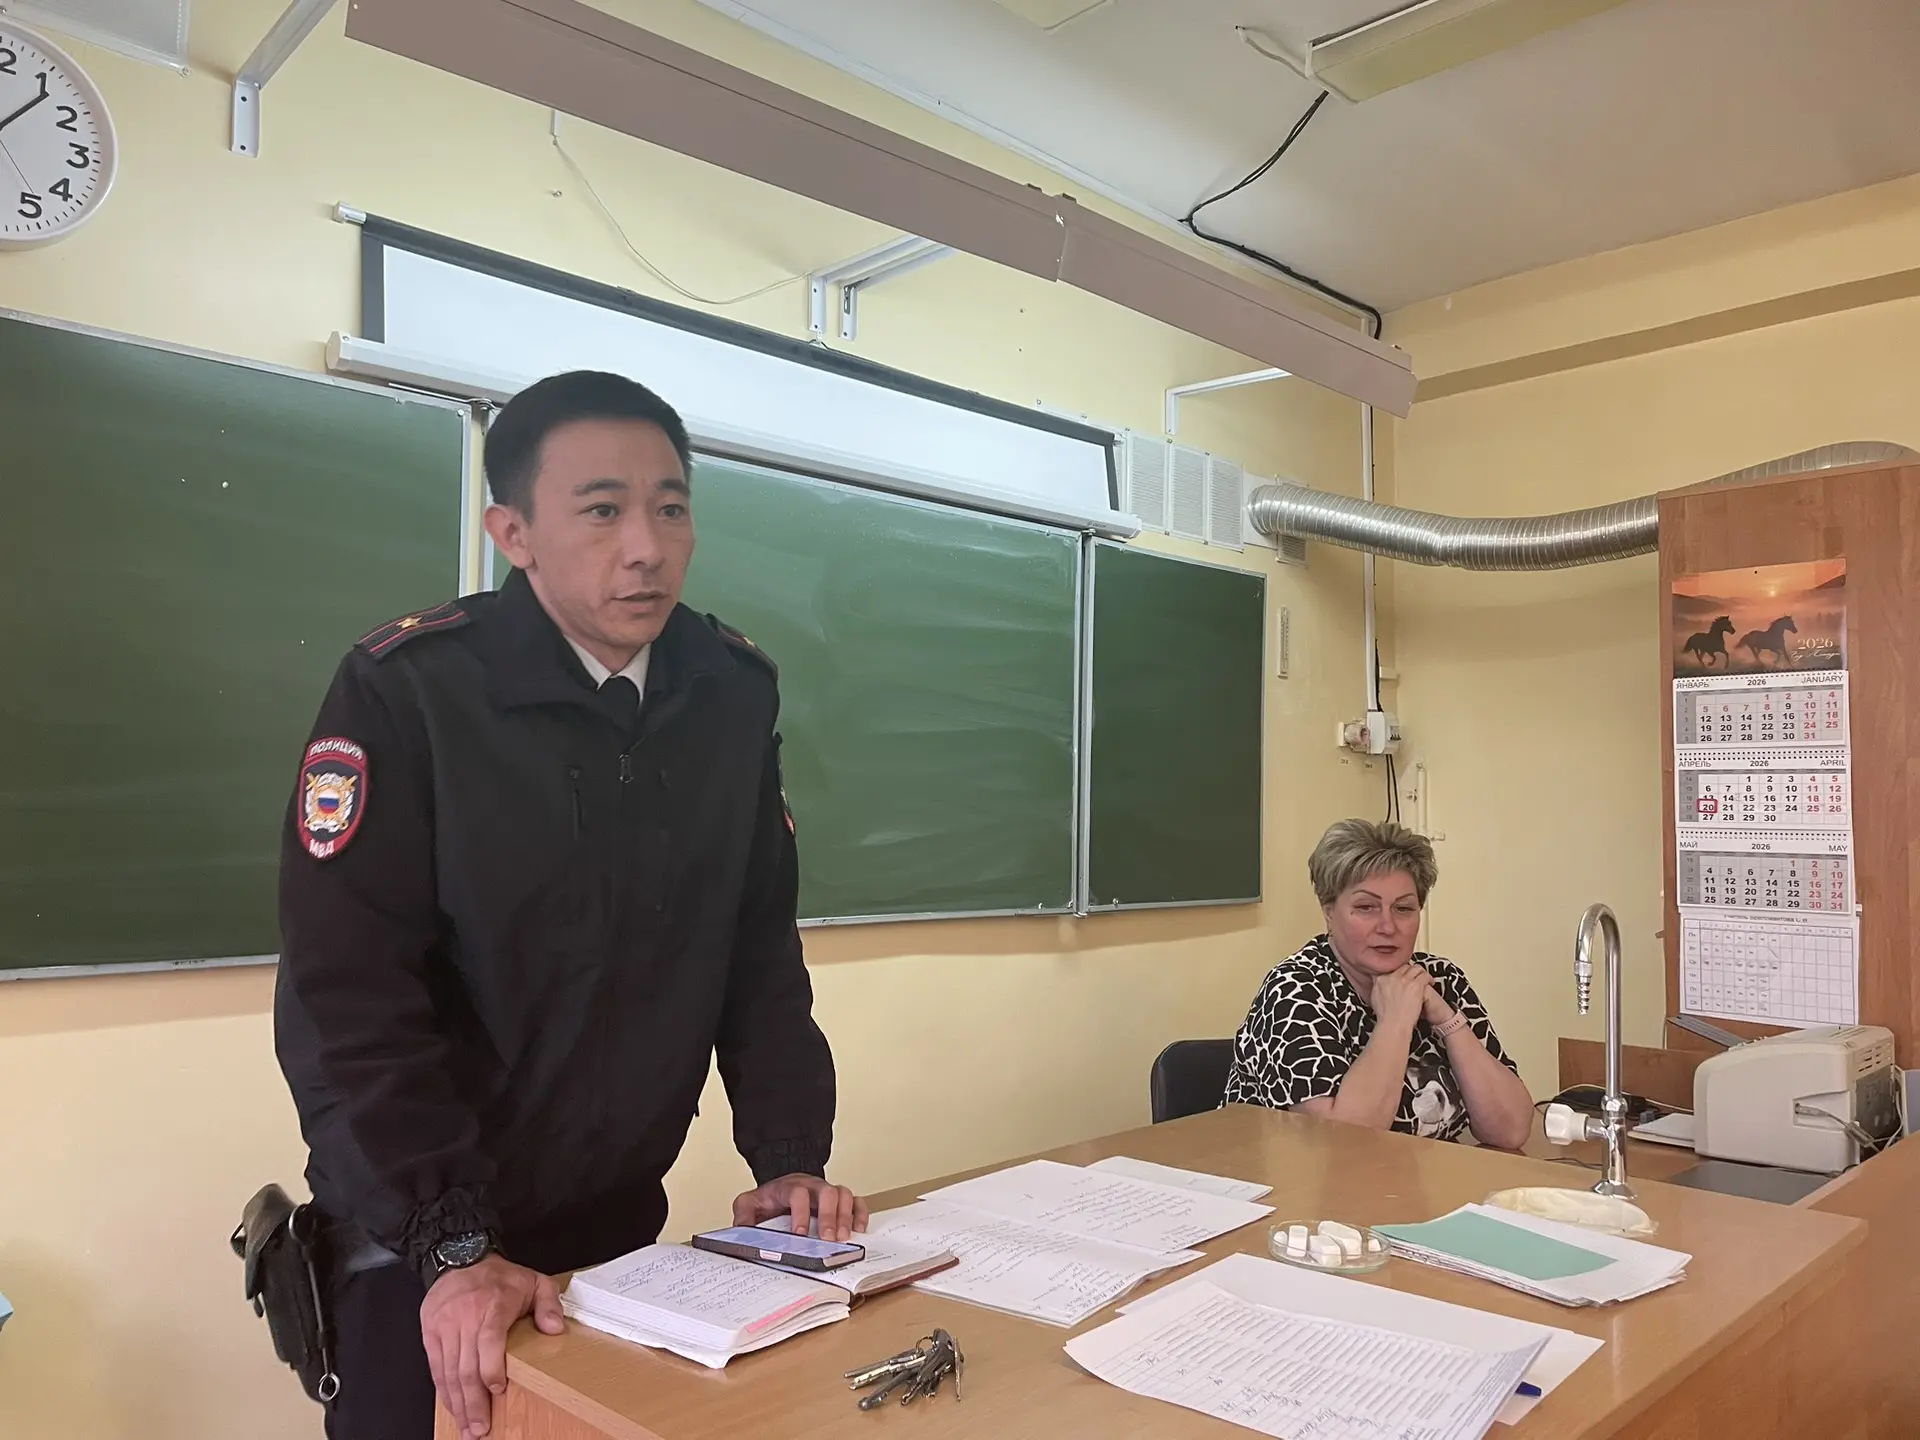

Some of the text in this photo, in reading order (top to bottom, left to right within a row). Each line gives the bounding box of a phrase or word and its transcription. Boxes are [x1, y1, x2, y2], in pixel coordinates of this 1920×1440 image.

[0, 47, 17, 75] 2
[35, 72, 47, 94] 1
[56, 105, 78, 132] 2
[66, 142, 89, 169] 3
[49, 178, 73, 202] 4
[17, 191, 42, 219] 5
[1797, 638, 1833, 649] 2026
[1801, 675, 1843, 683] JANUARY
[1804, 701, 1816, 709] 10
[1804, 711, 1816, 719] 17
[1761, 722, 1773, 730] 22
[1825, 720, 1838, 728] 25
[309, 740, 363, 760] ПОЛИЦИЯ
[1723, 794, 1734, 802] 14
[1743, 794, 1754, 803] 15
[1764, 795, 1776, 803] 16
[1702, 804, 1715, 812] 20
[1722, 804, 1734, 812] 21
[1763, 804, 1775, 812] 23
[1702, 813, 1713, 821] 27
[309, 839, 335, 858] МВД
[1704, 877, 1716, 885] 11
[1831, 881, 1842, 889] 17
[1744, 887, 1756, 895] 20
[1787, 889, 1799, 897] 22
[1808, 890, 1821, 898] 23
[1831, 891, 1843, 899] 24
[1724, 896, 1736, 904] 26
[1830, 902, 1842, 910] 31
